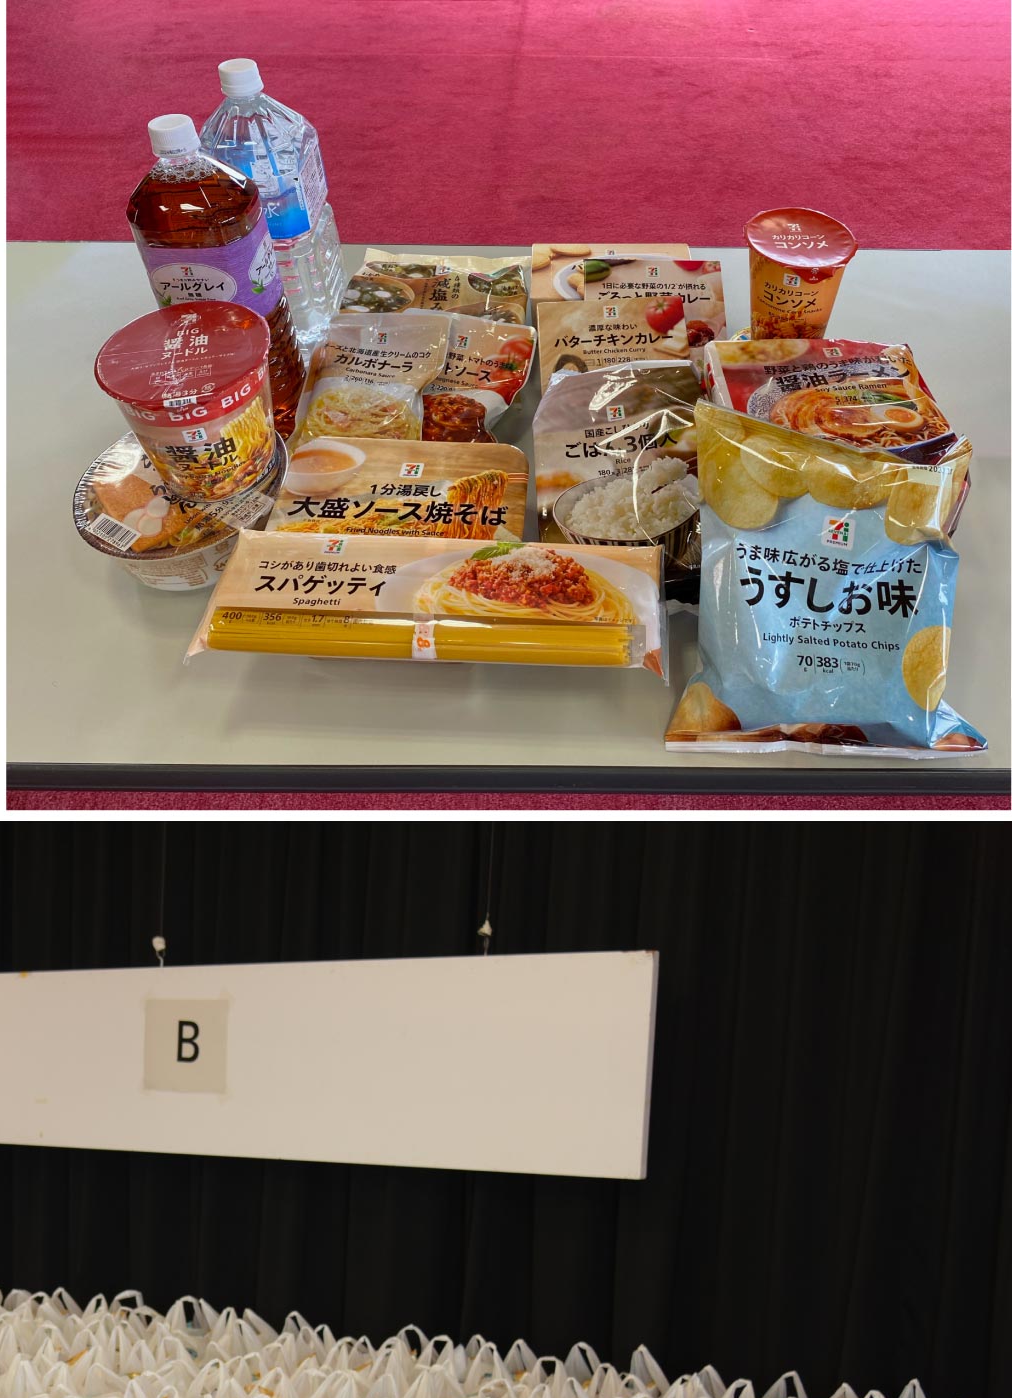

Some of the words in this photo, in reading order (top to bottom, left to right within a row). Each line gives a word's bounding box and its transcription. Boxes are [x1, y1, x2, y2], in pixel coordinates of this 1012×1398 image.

[774, 241, 829, 249] コンソメ
[160, 281, 225, 291] アールグレイ
[764, 282, 819, 297] カリカリコーン
[763, 289, 817, 309] コンソメ
[177, 328, 199, 336] BIG
[588, 323, 638, 332] 濃厚な味わい
[554, 332, 674, 348] バターチキンカレー
[161, 348, 208, 360] ヌードル
[334, 353, 413, 373] カルボナーラ
[776, 365, 910, 392] 醤油ラーメン
[221, 383, 251, 409] BIG
[166, 437, 237, 463] 醤油
[179, 454, 240, 471] ヌードル
[370, 483, 442, 497] 1分湯戻し
[287, 497, 509, 526] 大盛ソース焼そば
[368, 527, 400, 535] Noodles
[259, 560, 396, 575] コシがあり歯切れよい食感
[255, 575, 386, 596] スパゲッティ
[740, 566, 919, 619] うすしお味
[293, 597, 341, 607] Spaghetti
[222, 611, 242, 620] 400
[263, 613, 282, 621] 356
[789, 616, 866, 634] ポテトチップス
[763, 633, 794, 644] Lightly
[797, 635, 830, 646] Salted
[833, 639, 868, 649] Potato
[871, 641, 900, 651] Chips
[796, 655, 813, 667] 70
[816, 656, 839, 669] 383
[176, 1020, 200, 1063] B
